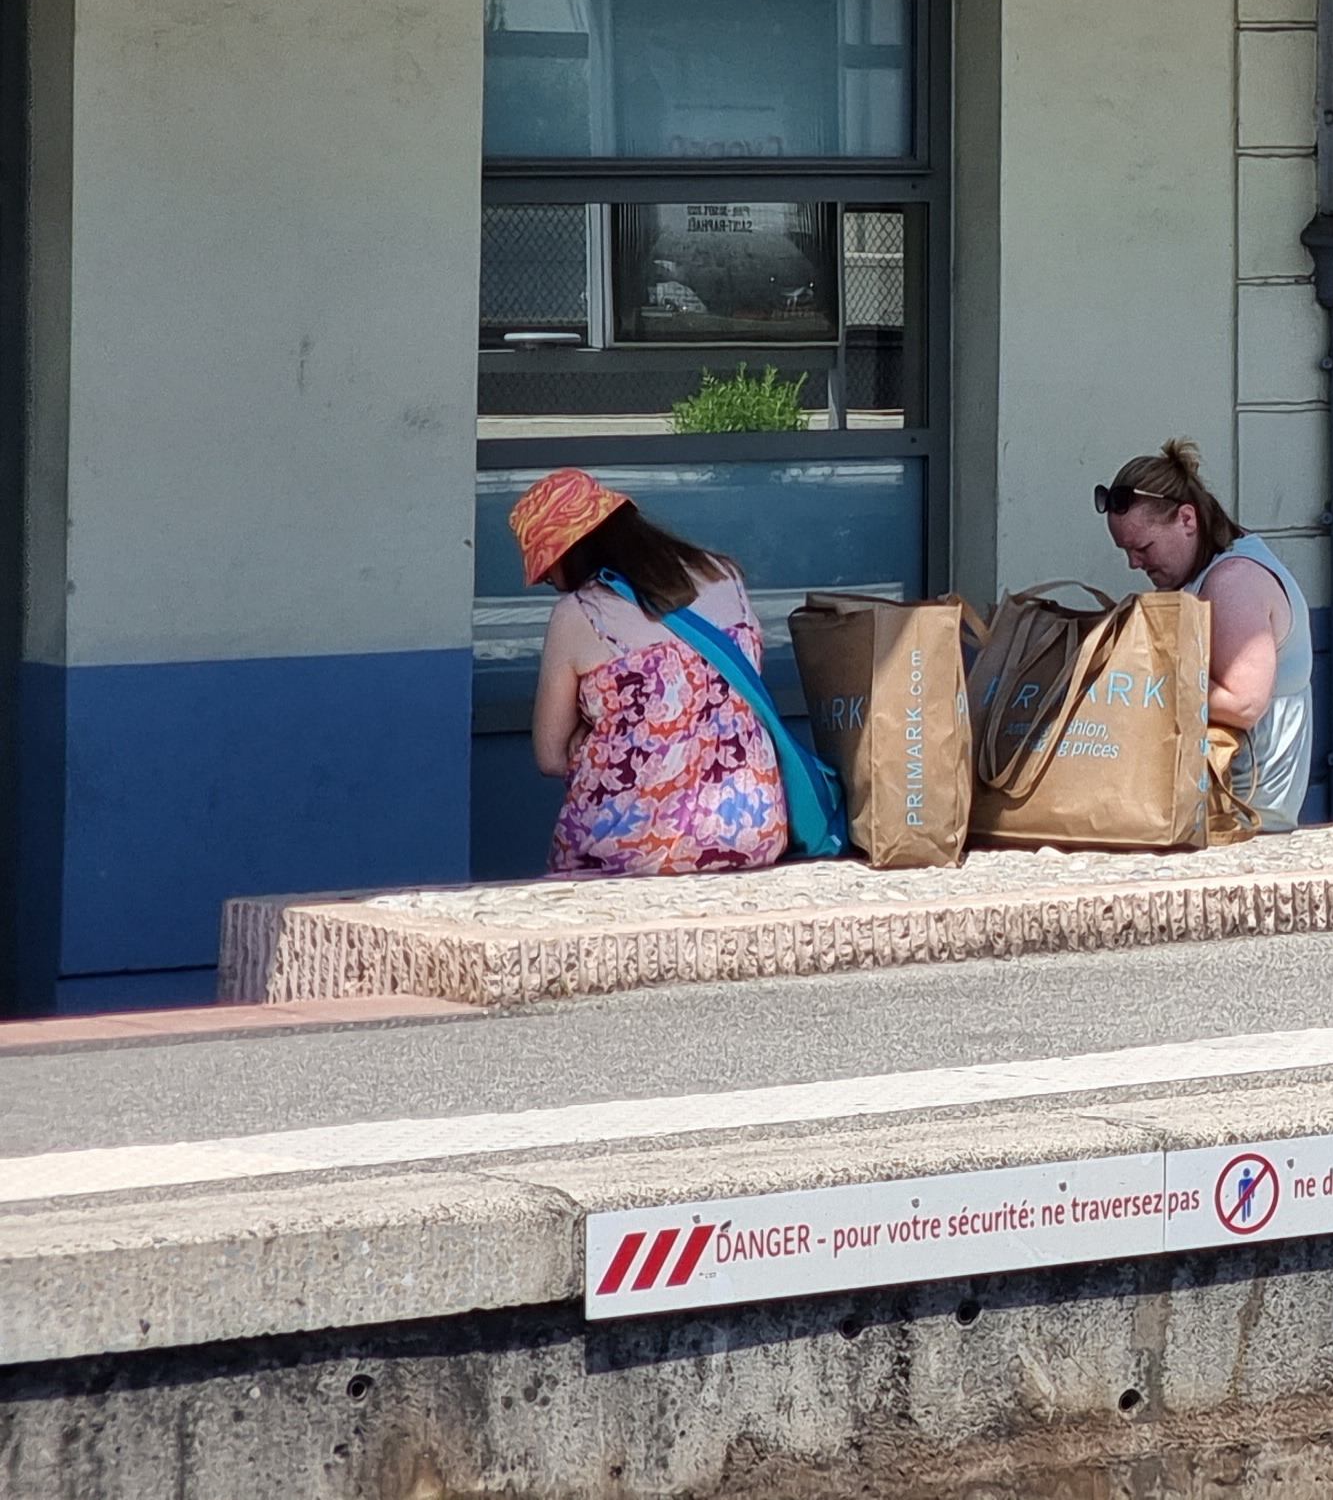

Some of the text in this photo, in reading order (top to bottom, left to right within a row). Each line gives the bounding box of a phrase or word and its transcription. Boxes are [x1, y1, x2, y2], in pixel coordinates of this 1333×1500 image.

[905, 649, 924, 826] PRIMARK.com
[1070, 740, 1120, 760] prices
[1293, 1175, 1317, 1199] ne
[715, 1223, 812, 1264] DANGER
[833, 1223, 882, 1259] pour
[887, 1214, 942, 1247] votre
[948, 1198, 1036, 1238] sécurité:
[1041, 1204, 1066, 1228] ne
[1070, 1193, 1163, 1224] traversez
[1168, 1187, 1201, 1221] pas
